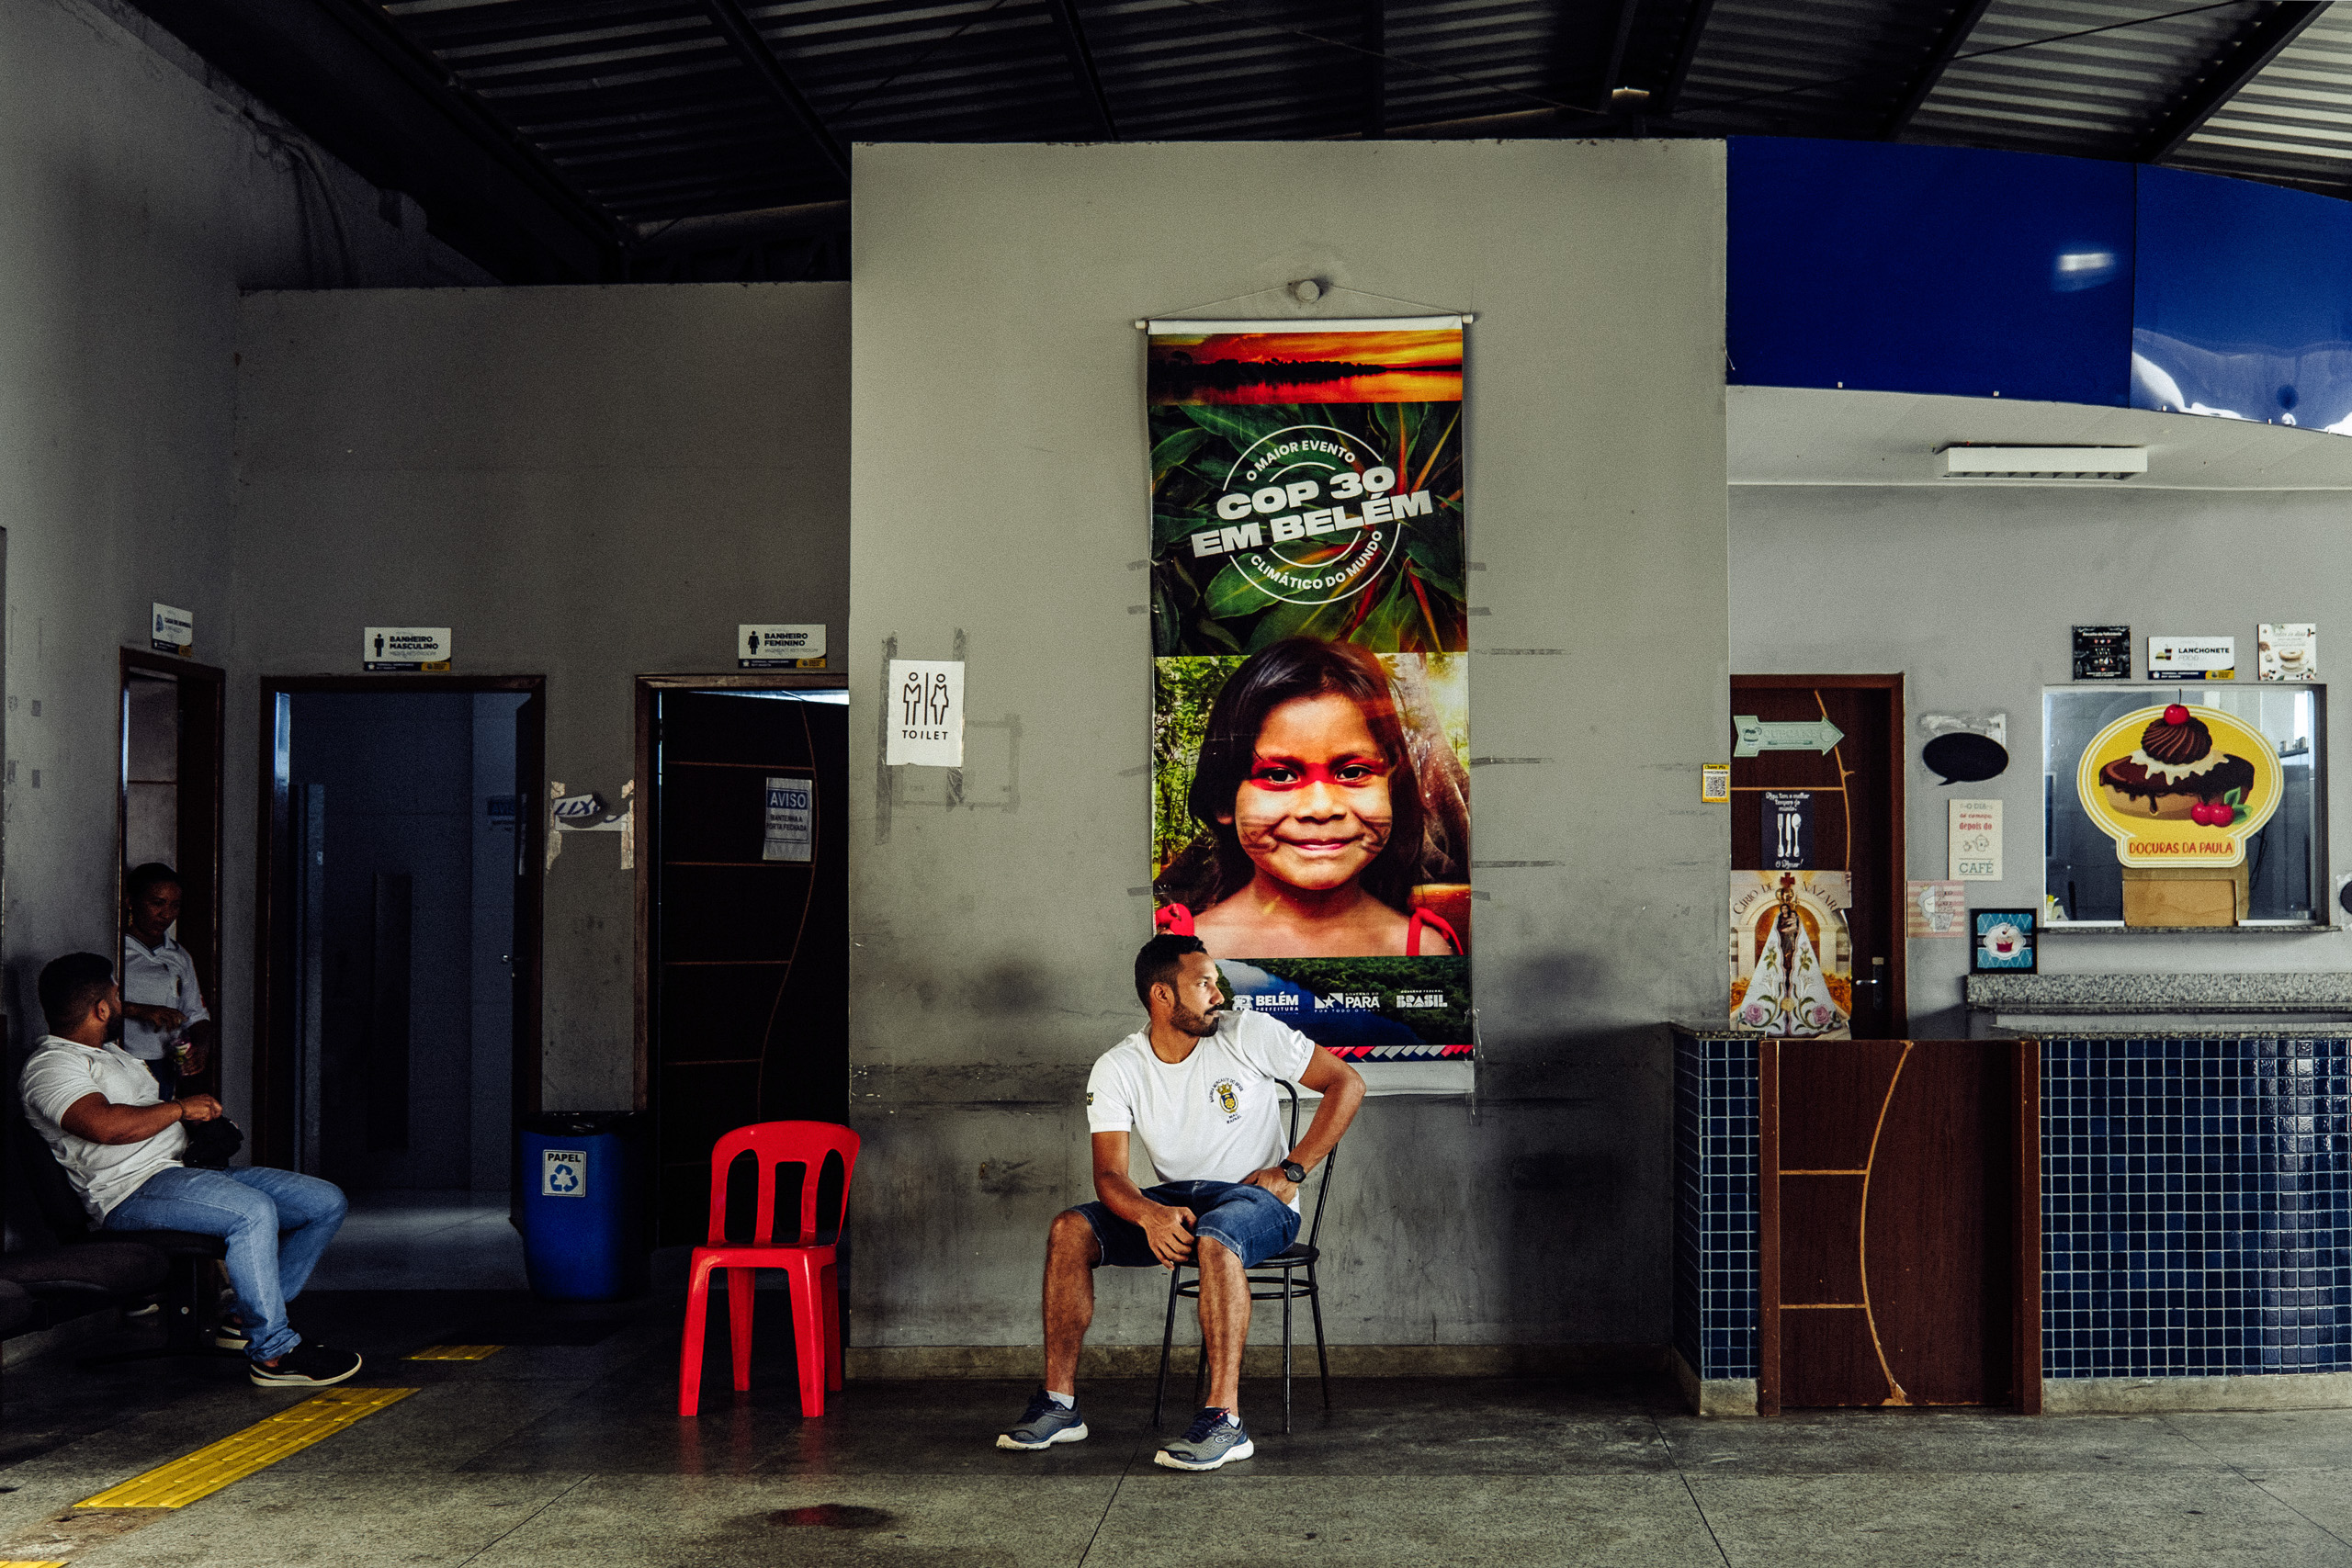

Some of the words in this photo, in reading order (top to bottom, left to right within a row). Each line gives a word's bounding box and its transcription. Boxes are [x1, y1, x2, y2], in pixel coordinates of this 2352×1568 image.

[1246, 470, 1258, 481] O
[1253, 441, 1299, 472] MAIOR
[1301, 440, 1356, 463] EVENTO
[1216, 479, 1319, 520] COP
[1329, 466, 1396, 499] 30
[1191, 522, 1263, 558] EM
[1270, 490, 1433, 542] BELÉM
[1250, 555, 1323, 590] CLIMÁTICO
[1326, 571, 1346, 588] DO
[1345, 530, 1383, 579] MUNDO
[902, 730, 948, 740] TOILET
[770, 792, 806, 808] AVISO
[1959, 822, 1982, 831] depois
[1984, 822, 1993, 830] do
[2129, 841, 2179, 855] DOÇURAS
[2182, 841, 2197, 854] DA
[2199, 841, 2233, 854] PAULA
[1959, 860, 1994, 874] CAFÉ
[1255, 991, 1299, 1007] BELÉM
[1396, 994, 1448, 1009] BRASIL
[548, 1153, 582, 1163] PAPEL
